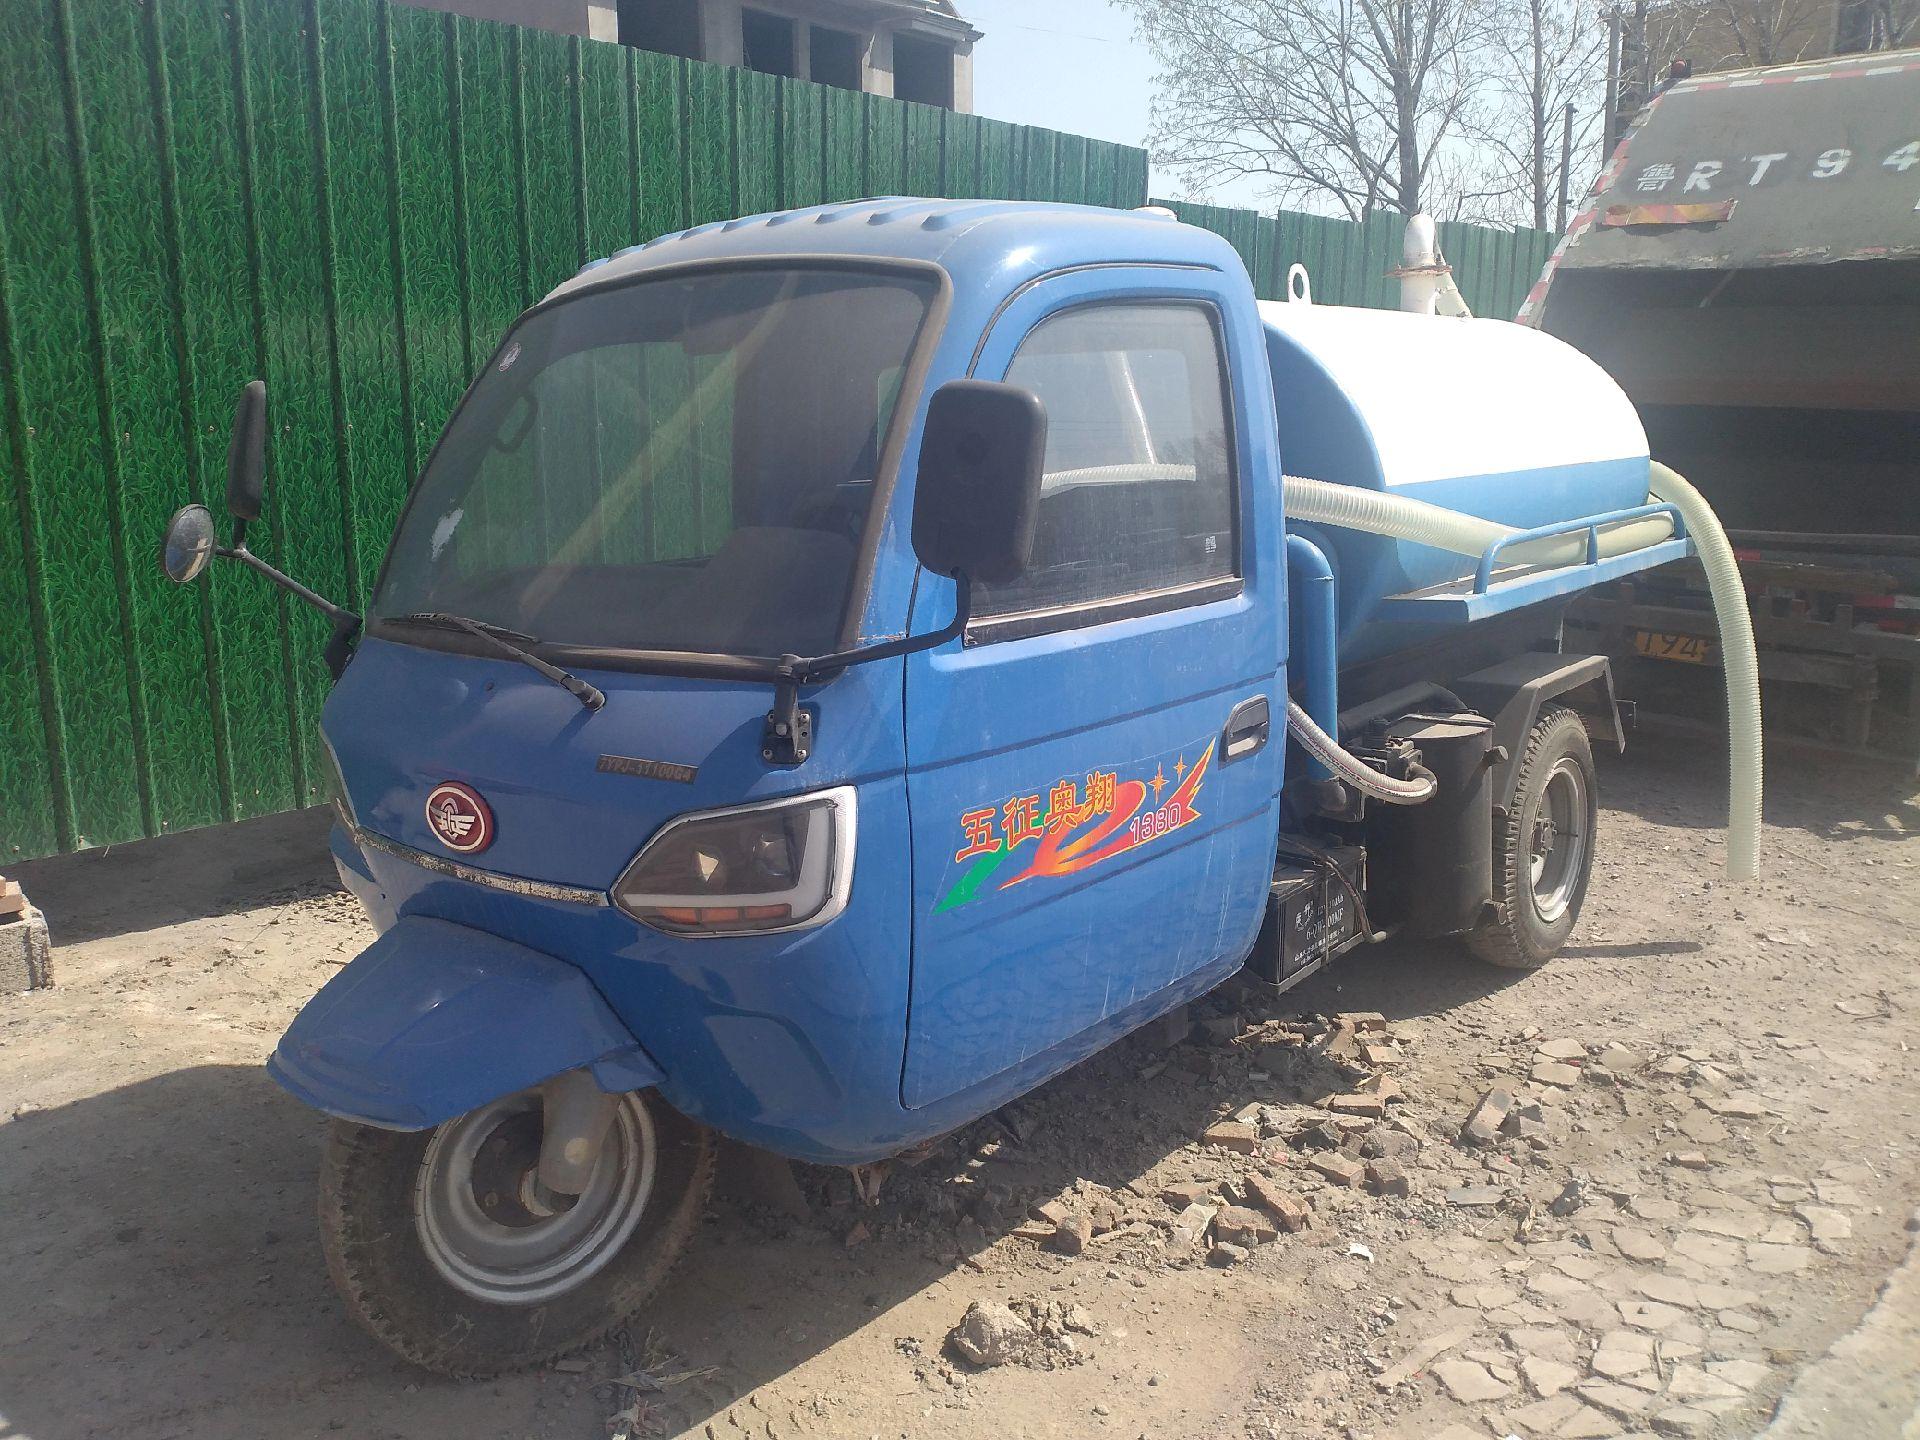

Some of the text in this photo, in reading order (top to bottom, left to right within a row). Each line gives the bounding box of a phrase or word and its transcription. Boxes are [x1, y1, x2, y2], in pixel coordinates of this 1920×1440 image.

[955, 771, 1117, 864] 五征奥翔
[1129, 802, 1182, 844] 1380
